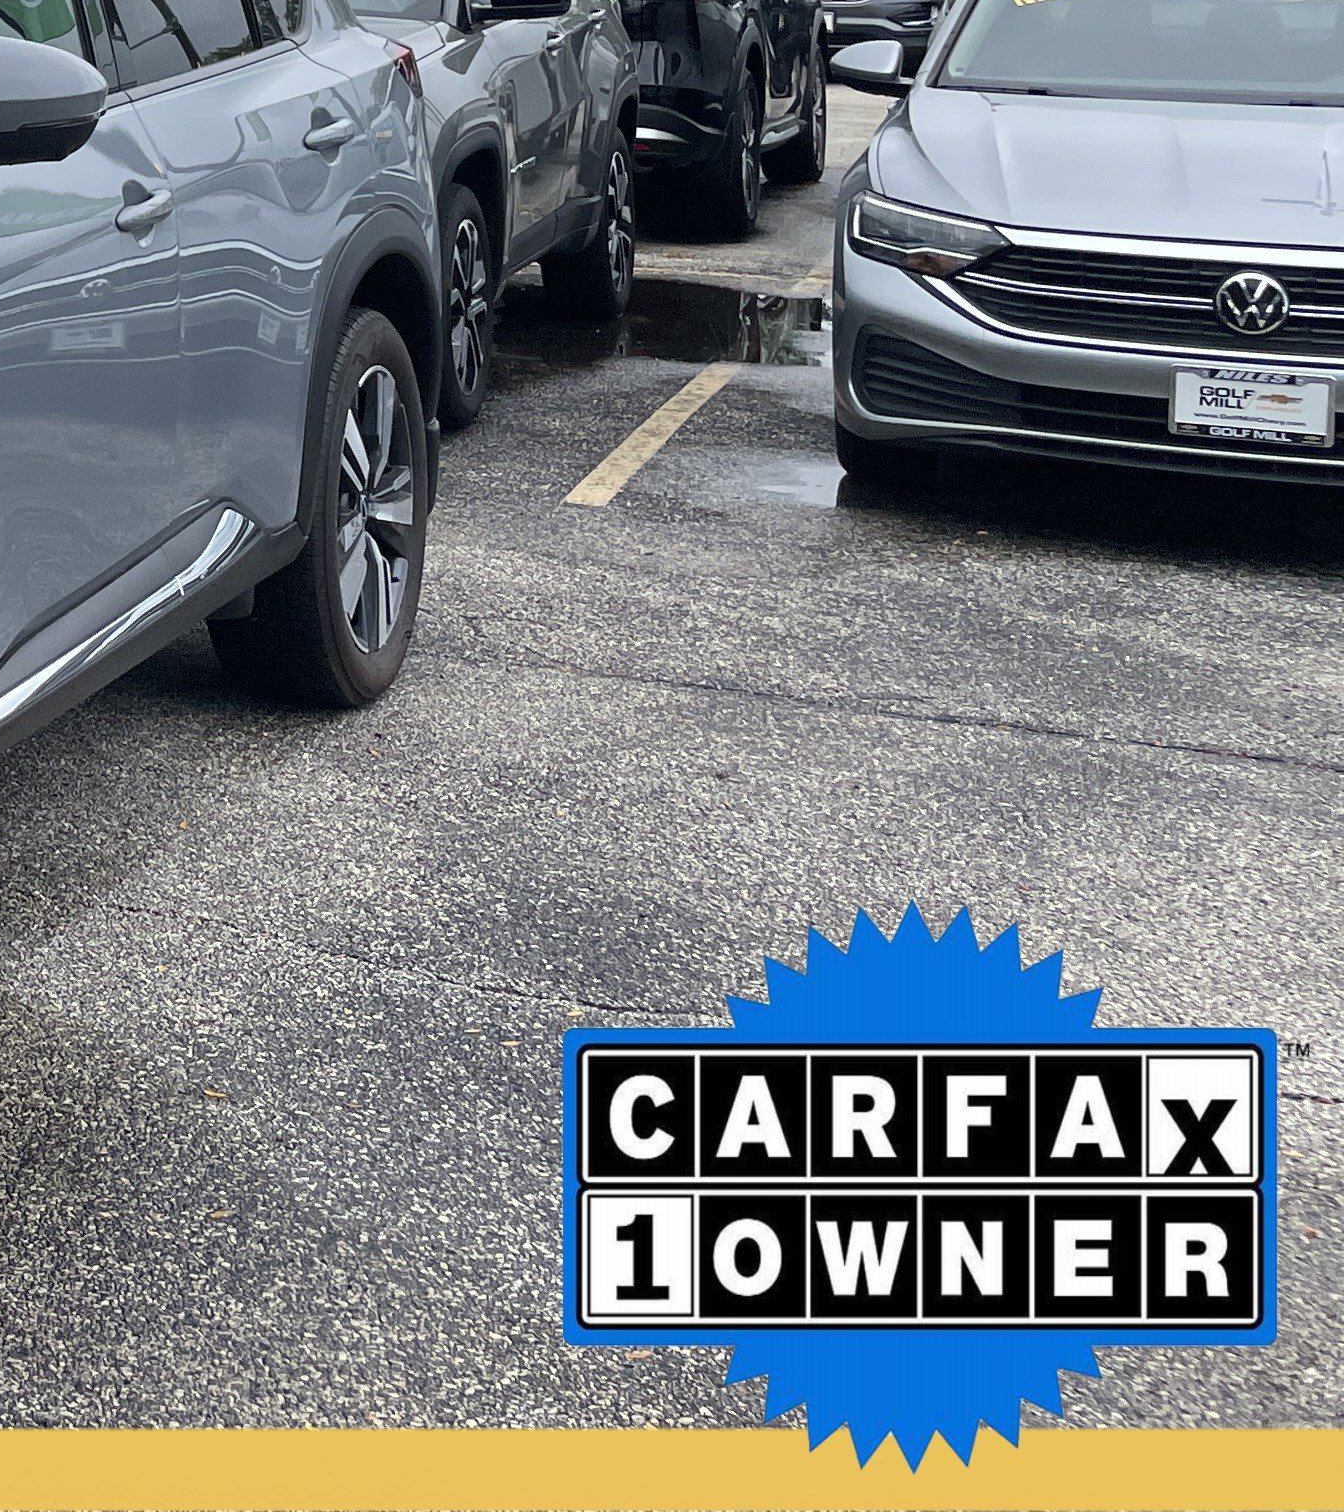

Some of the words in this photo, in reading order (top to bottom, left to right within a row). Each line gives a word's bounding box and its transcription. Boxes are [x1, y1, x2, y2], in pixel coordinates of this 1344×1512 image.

[1215, 370, 1291, 384] NILES
[1199, 385, 1255, 400] GOLF
[1199, 396, 1244, 410] MILL
[1209, 426, 1251, 438] GOLF
[1253, 430, 1292, 442] MILL
